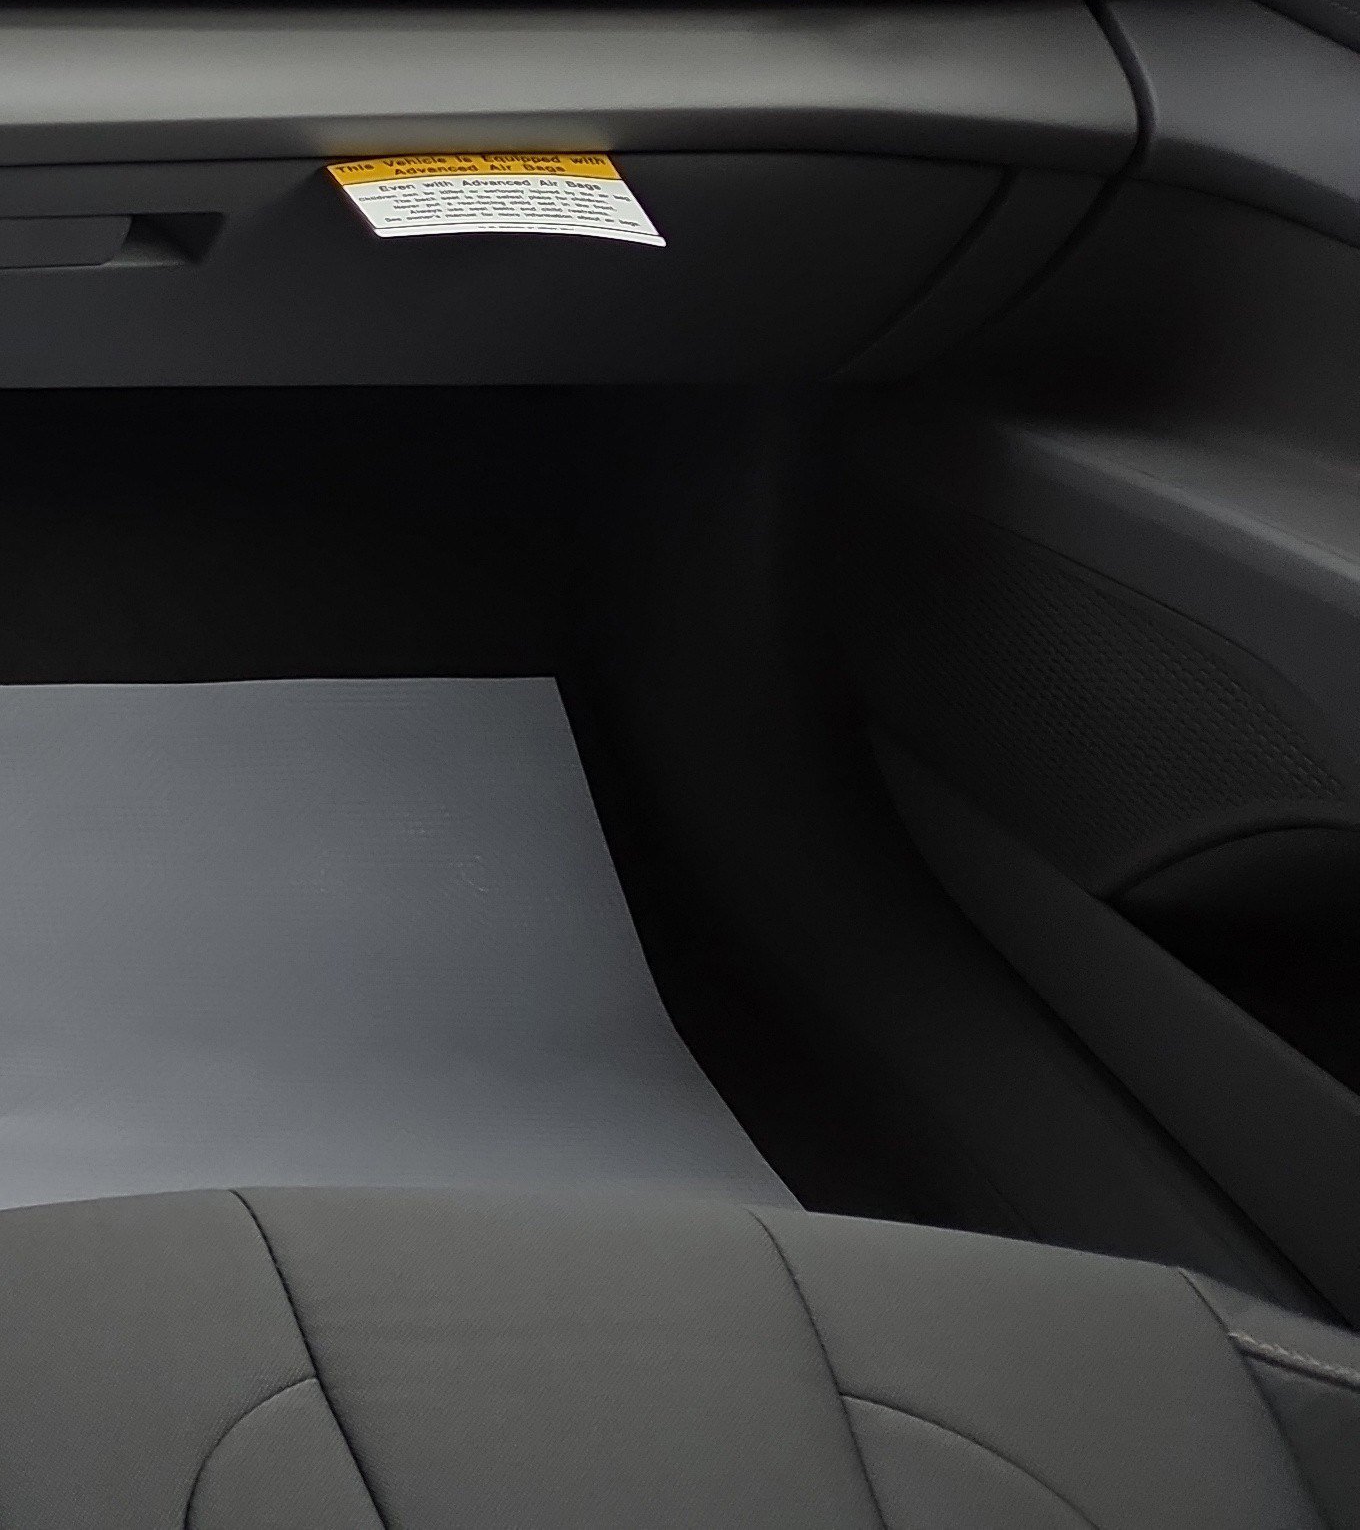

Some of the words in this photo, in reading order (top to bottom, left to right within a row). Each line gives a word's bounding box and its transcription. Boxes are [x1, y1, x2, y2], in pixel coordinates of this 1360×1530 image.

[336, 163, 375, 173] This
[382, 154, 448, 167] Vehicle
[482, 153, 561, 164] Equipped
[569, 155, 607, 166] with
[394, 164, 479, 176] Advanced
[490, 163, 512, 172] Air
[523, 164, 567, 173] Bags
[378, 183, 417, 192] Even
[422, 179, 454, 188] with
[462, 179, 532, 187] Advanced
[540, 179, 559, 187] Air
[565, 180, 602, 190] Bags
